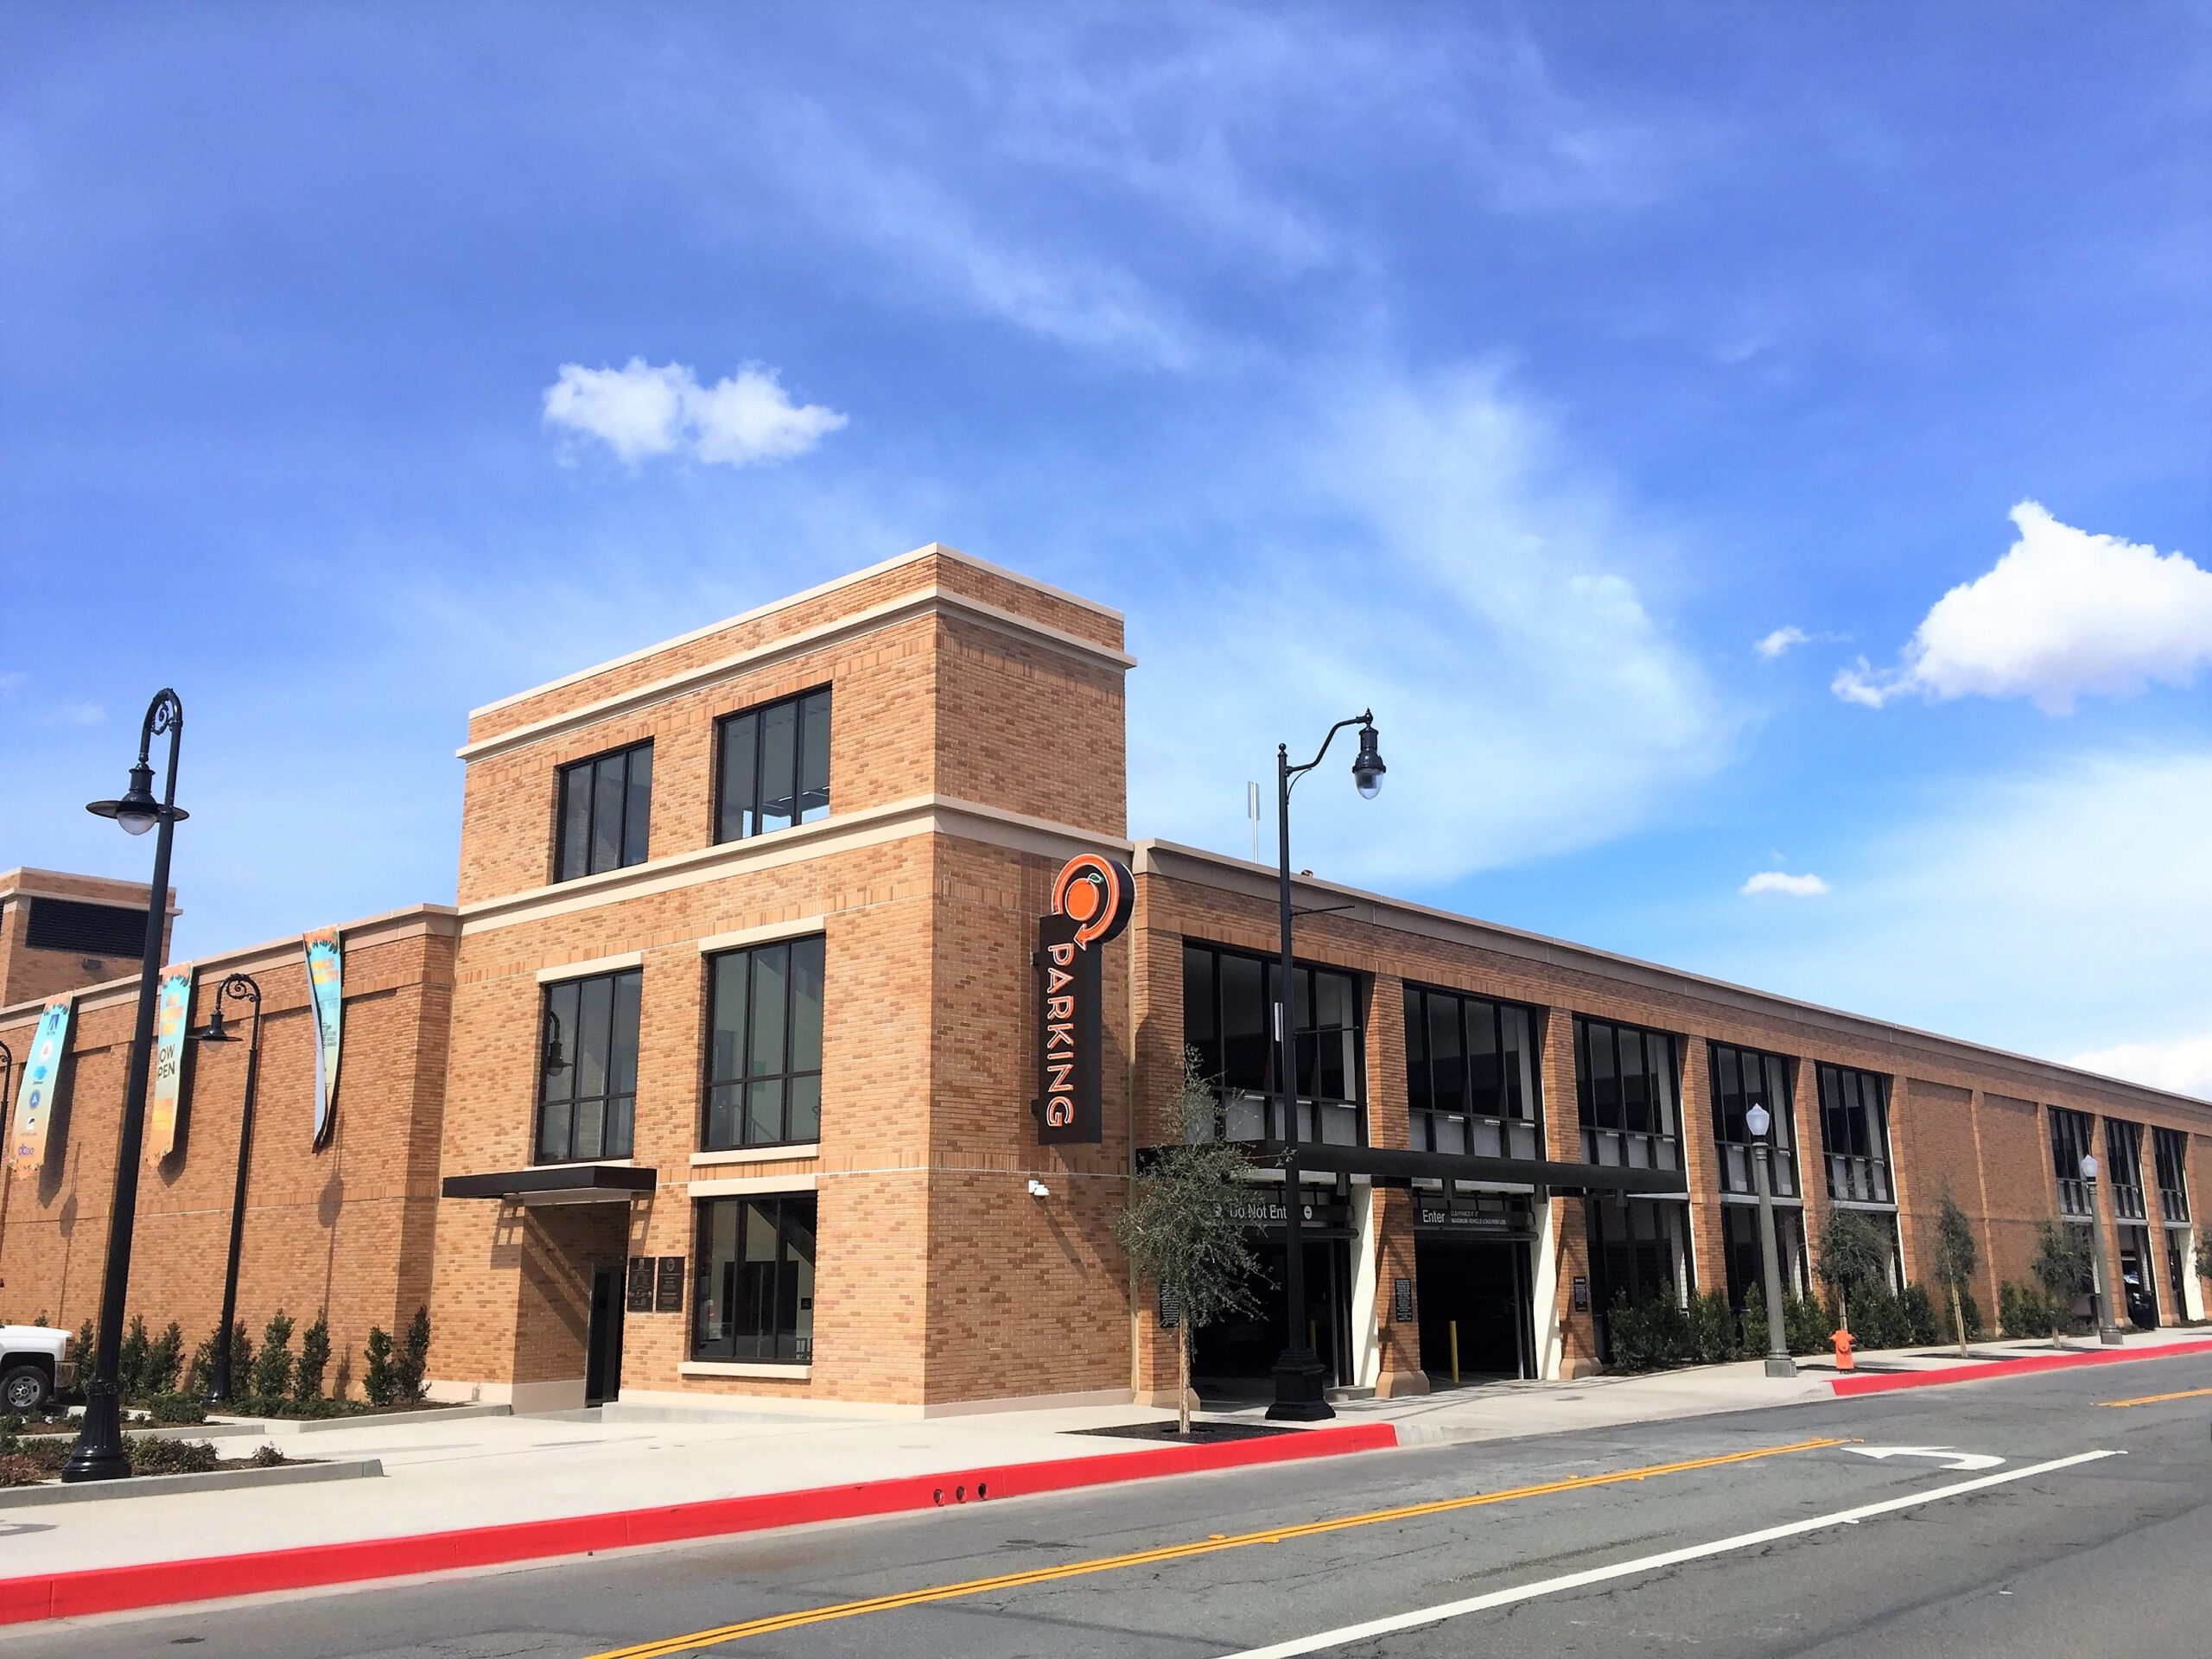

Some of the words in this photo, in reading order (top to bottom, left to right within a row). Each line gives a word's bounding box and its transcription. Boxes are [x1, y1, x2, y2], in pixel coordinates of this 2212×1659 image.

[1046, 943, 1075, 1128] PARKING
[159, 1043, 175, 1064] OW
[157, 1060, 175, 1081] PEN
[1248, 1204, 1268, 1218] Not
[1269, 1205, 1287, 1219] Ent
[1422, 1210, 1446, 1224] Enter
